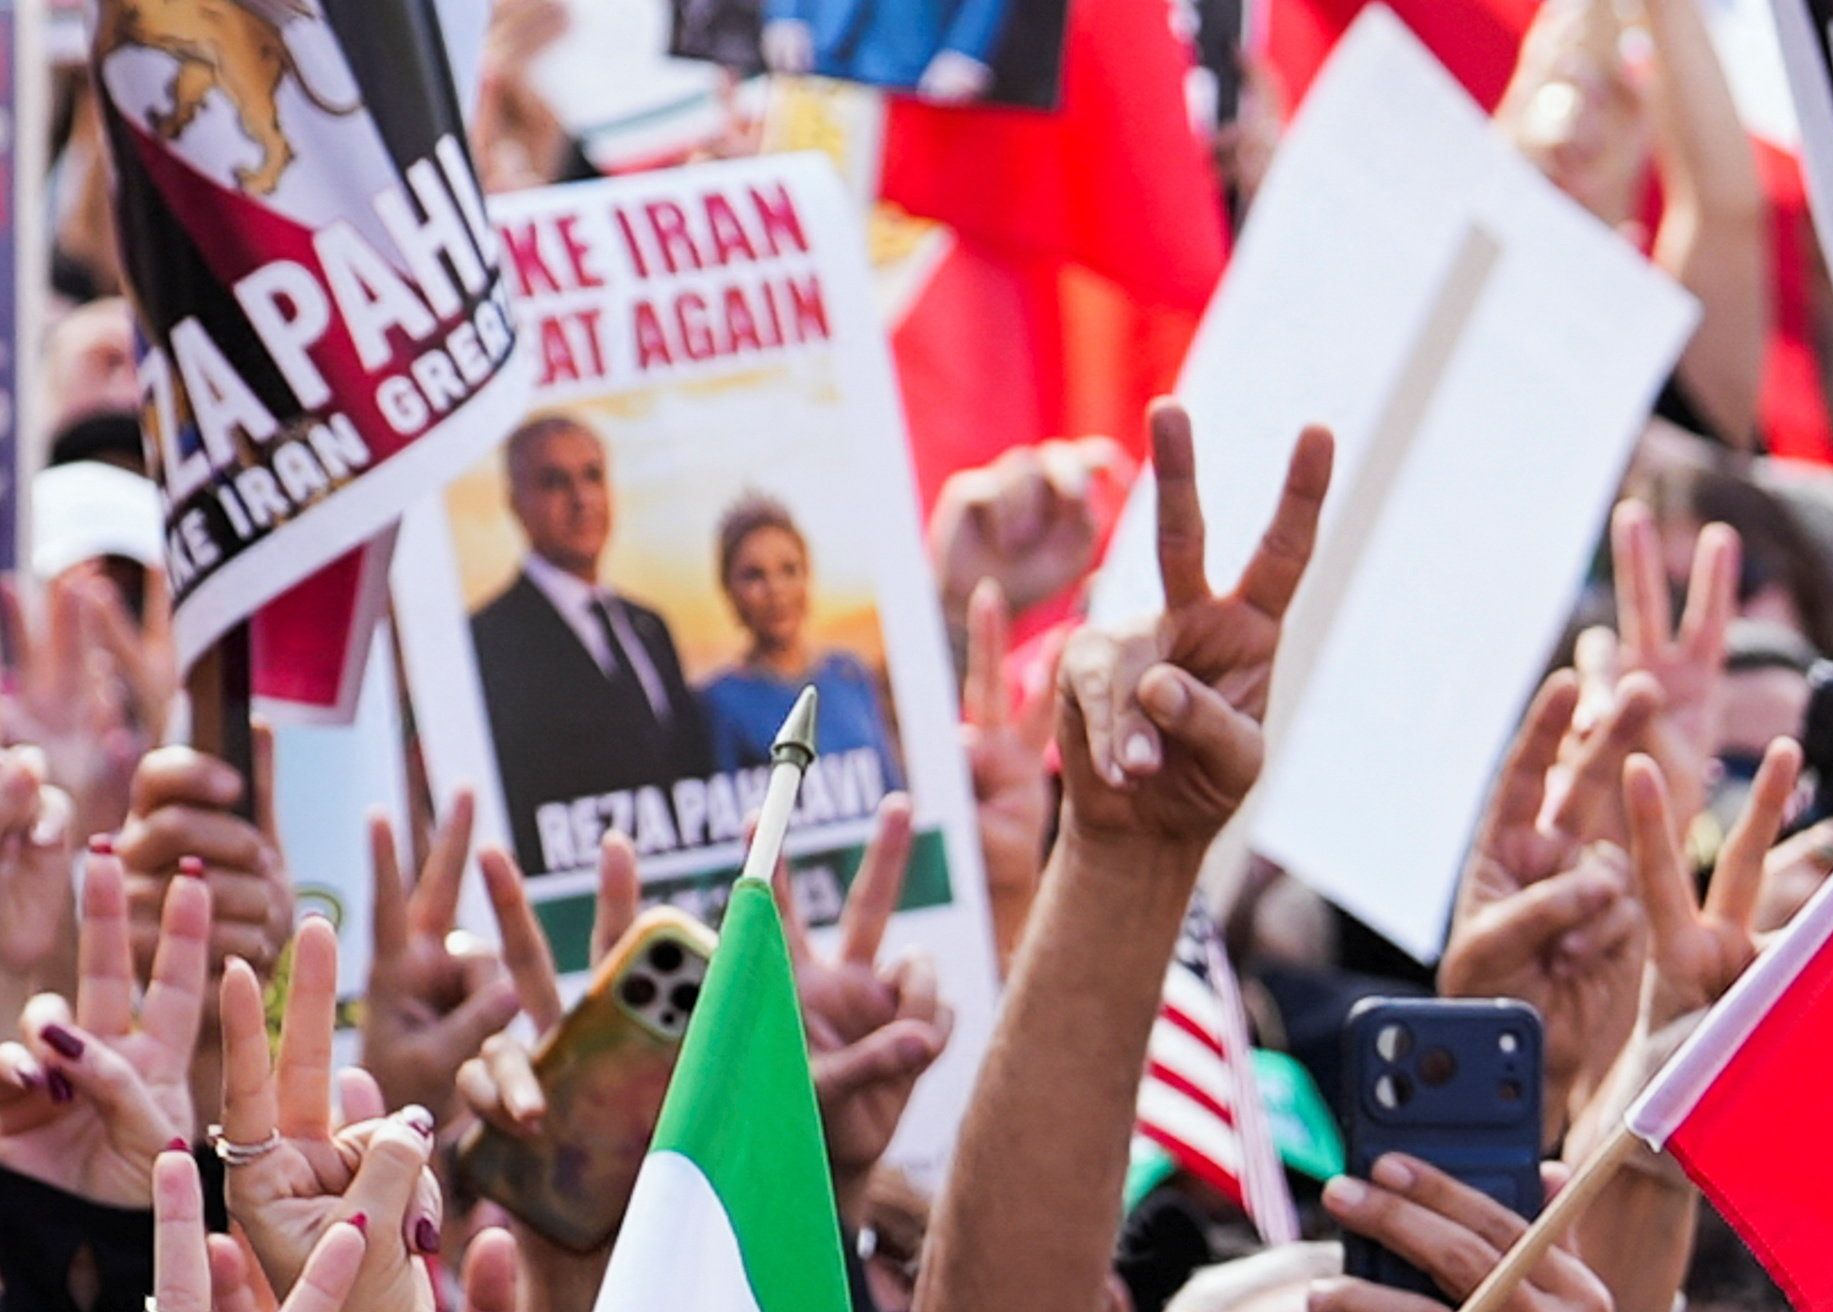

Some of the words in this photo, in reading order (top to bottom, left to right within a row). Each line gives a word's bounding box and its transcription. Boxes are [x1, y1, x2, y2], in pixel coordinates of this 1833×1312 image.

[614, 181, 810, 280] IRAN
[634, 274, 833, 371] AGAIN
[217, 412, 371, 542] IRAN
[536, 784, 677, 872] REZA
[671, 746, 886, 848] PAHAVI
